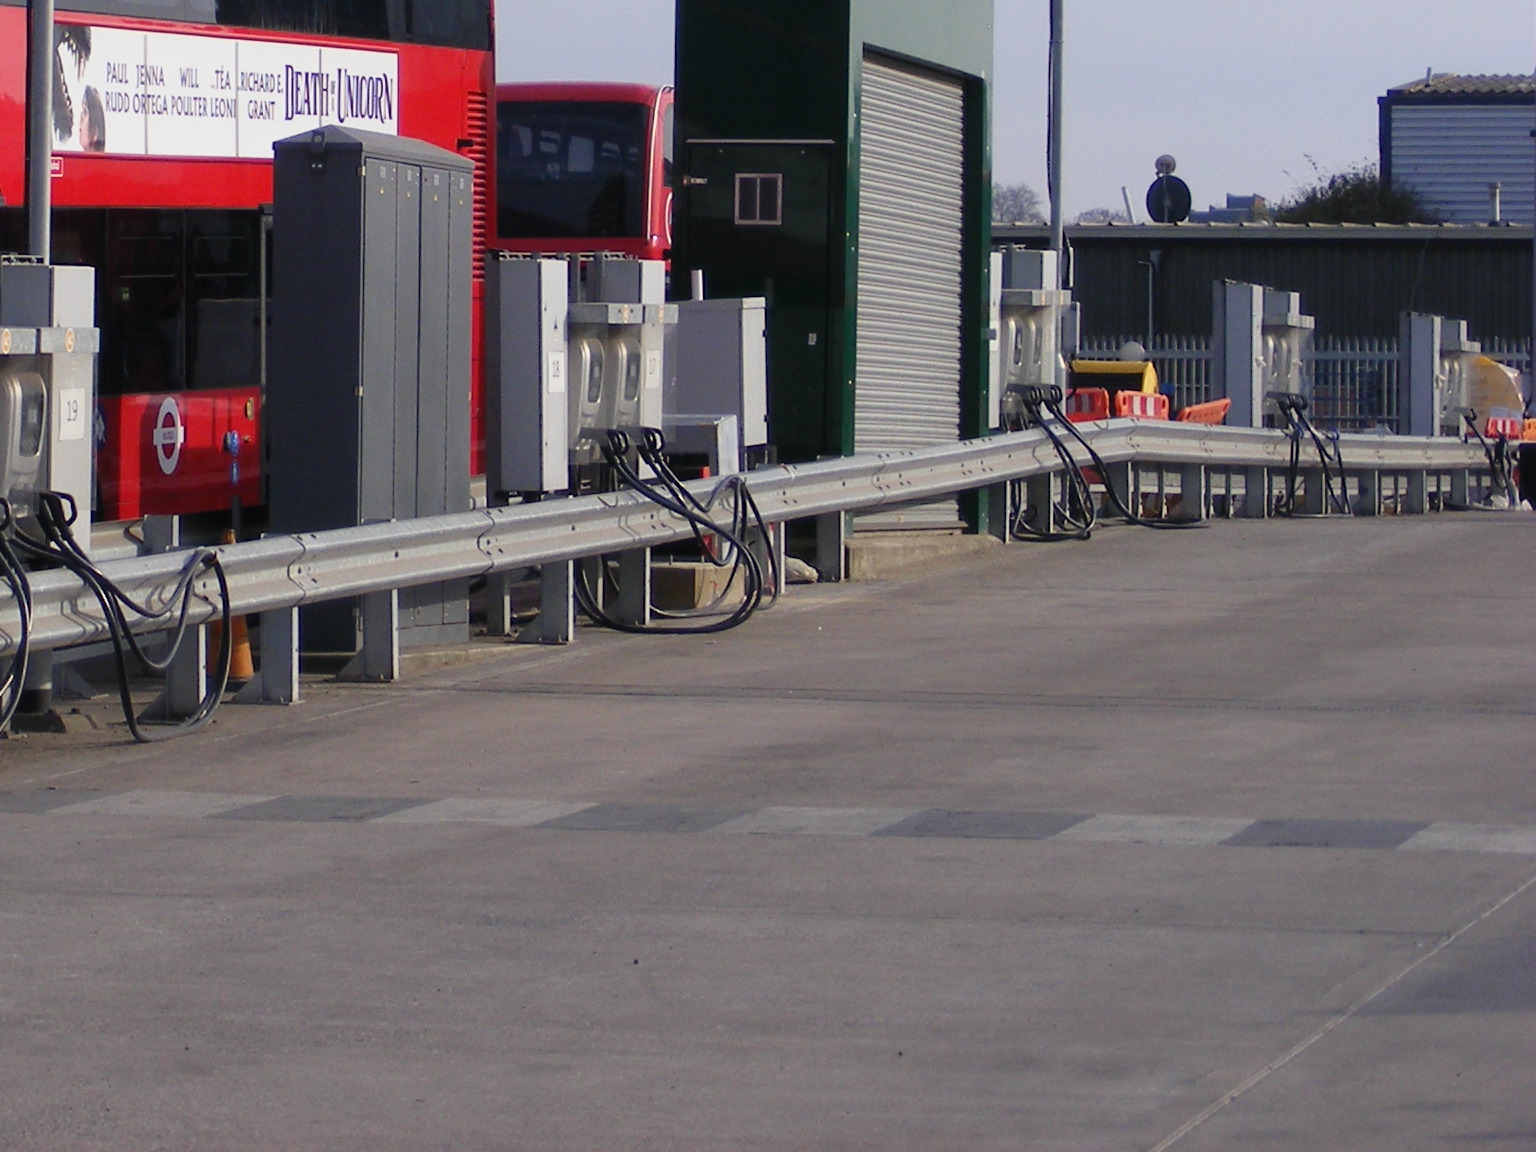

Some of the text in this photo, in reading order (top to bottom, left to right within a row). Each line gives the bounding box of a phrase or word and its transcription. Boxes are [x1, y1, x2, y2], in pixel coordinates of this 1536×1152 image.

[106, 61, 129, 84] PAUL
[136, 64, 165, 89] JENNA
[180, 67, 199, 89] WILL
[240, 71, 275, 93] RICHARD
[105, 91, 276, 120] RUDD ORTEGA POULTER LEONI GRANT
[284, 64, 329, 120] DEATH
[337, 68, 394, 124] UNICORN
[66, 399, 78, 422] 19
